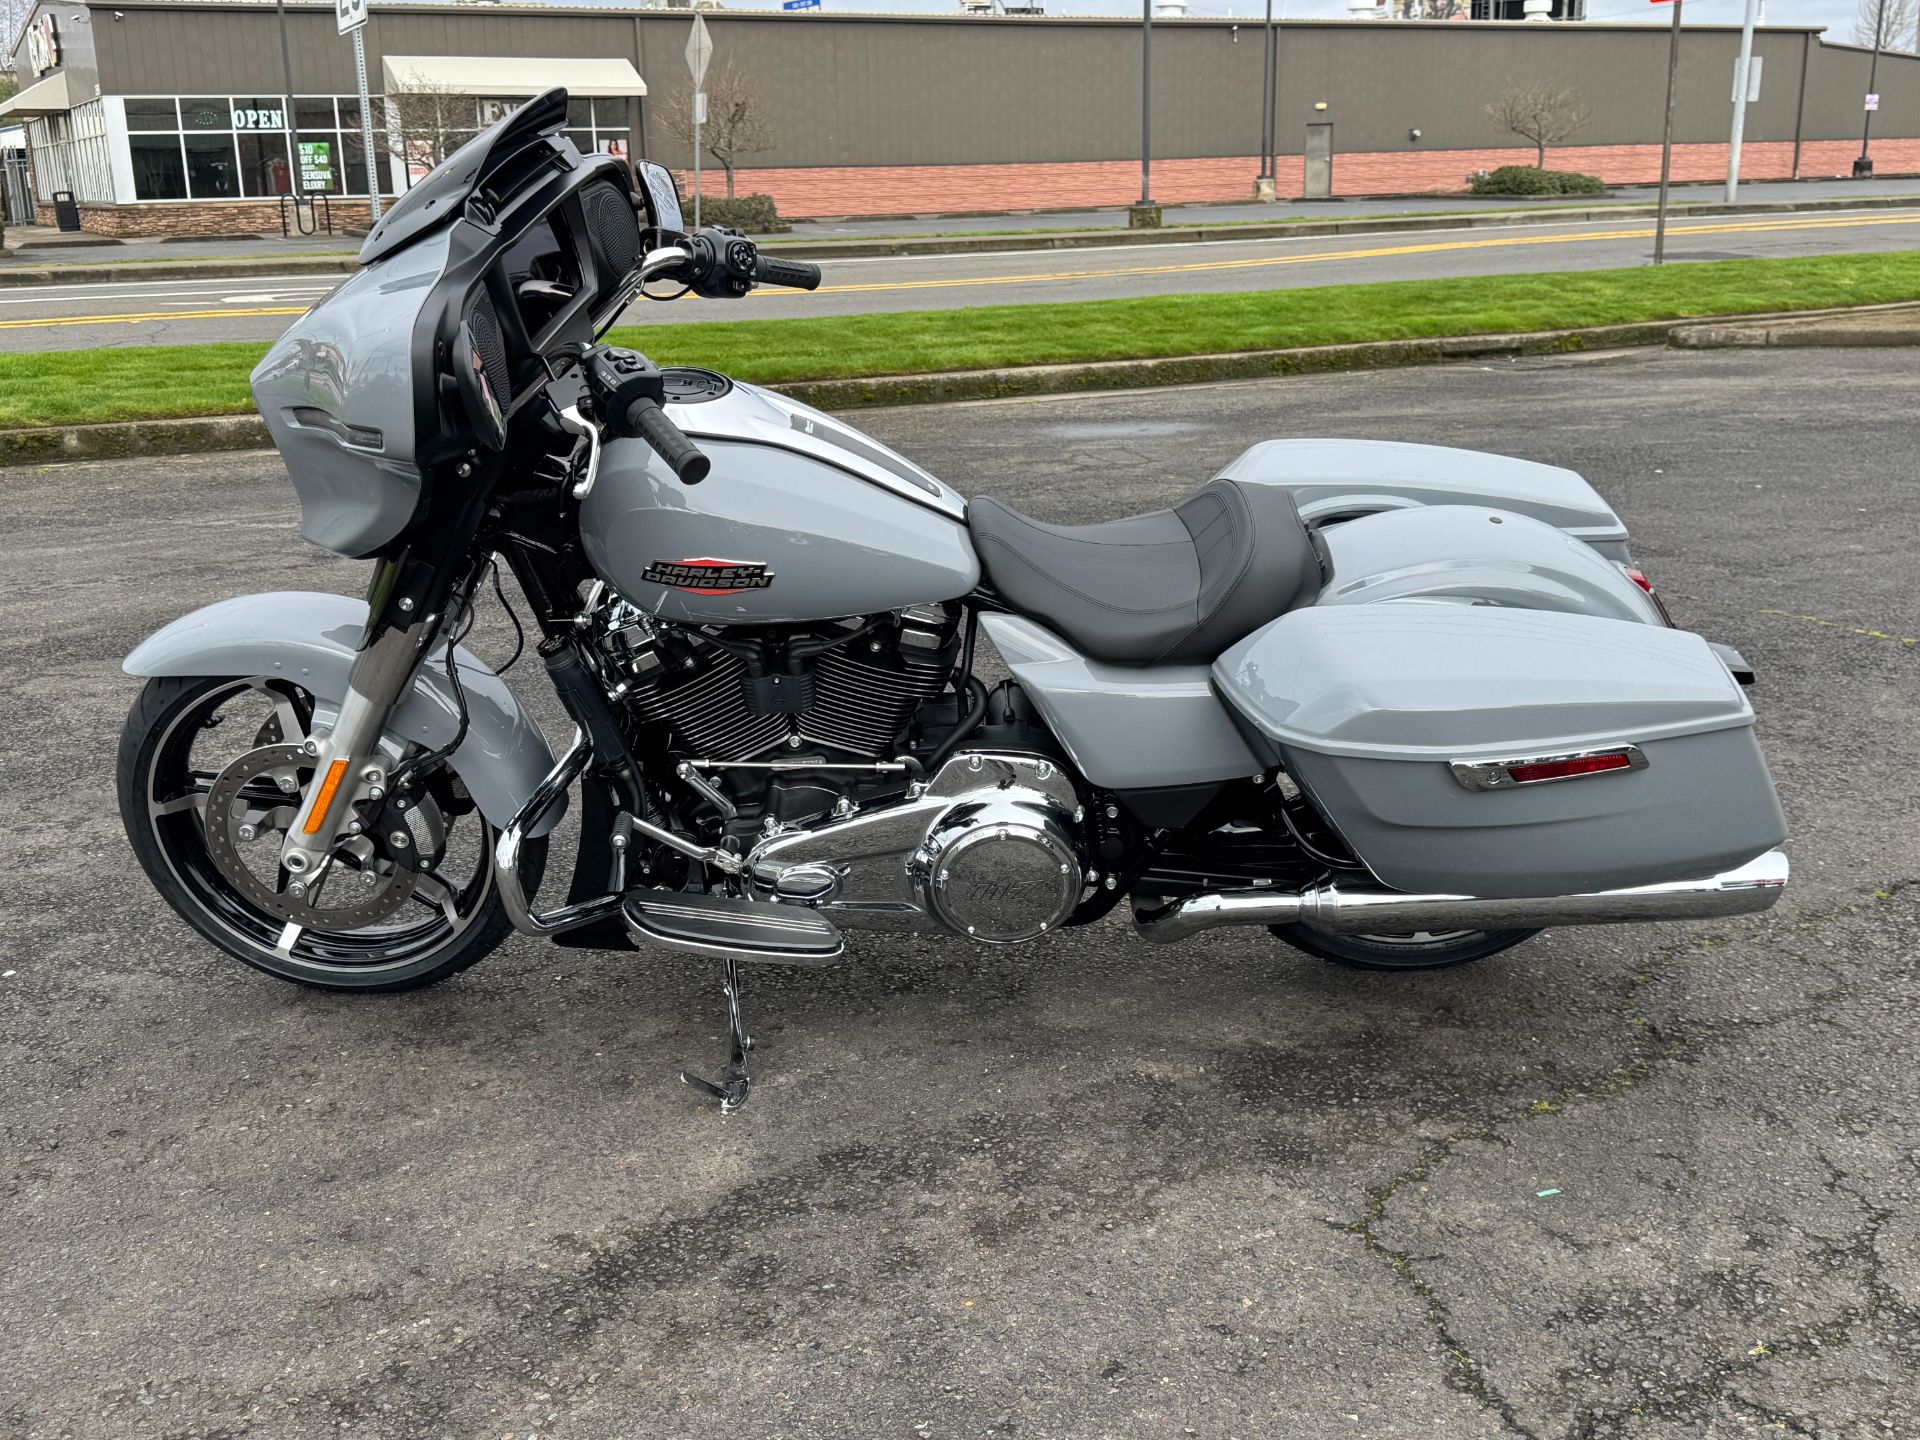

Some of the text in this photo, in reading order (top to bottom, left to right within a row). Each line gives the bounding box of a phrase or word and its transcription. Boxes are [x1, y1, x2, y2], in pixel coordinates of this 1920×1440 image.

[234, 110, 282, 128] OPEN
[299, 144, 313, 155] $10
[300, 155, 328, 164] OFF $40
[655, 564, 761, 578] HARLEY-
[645, 572, 768, 588] DAVIDSON
